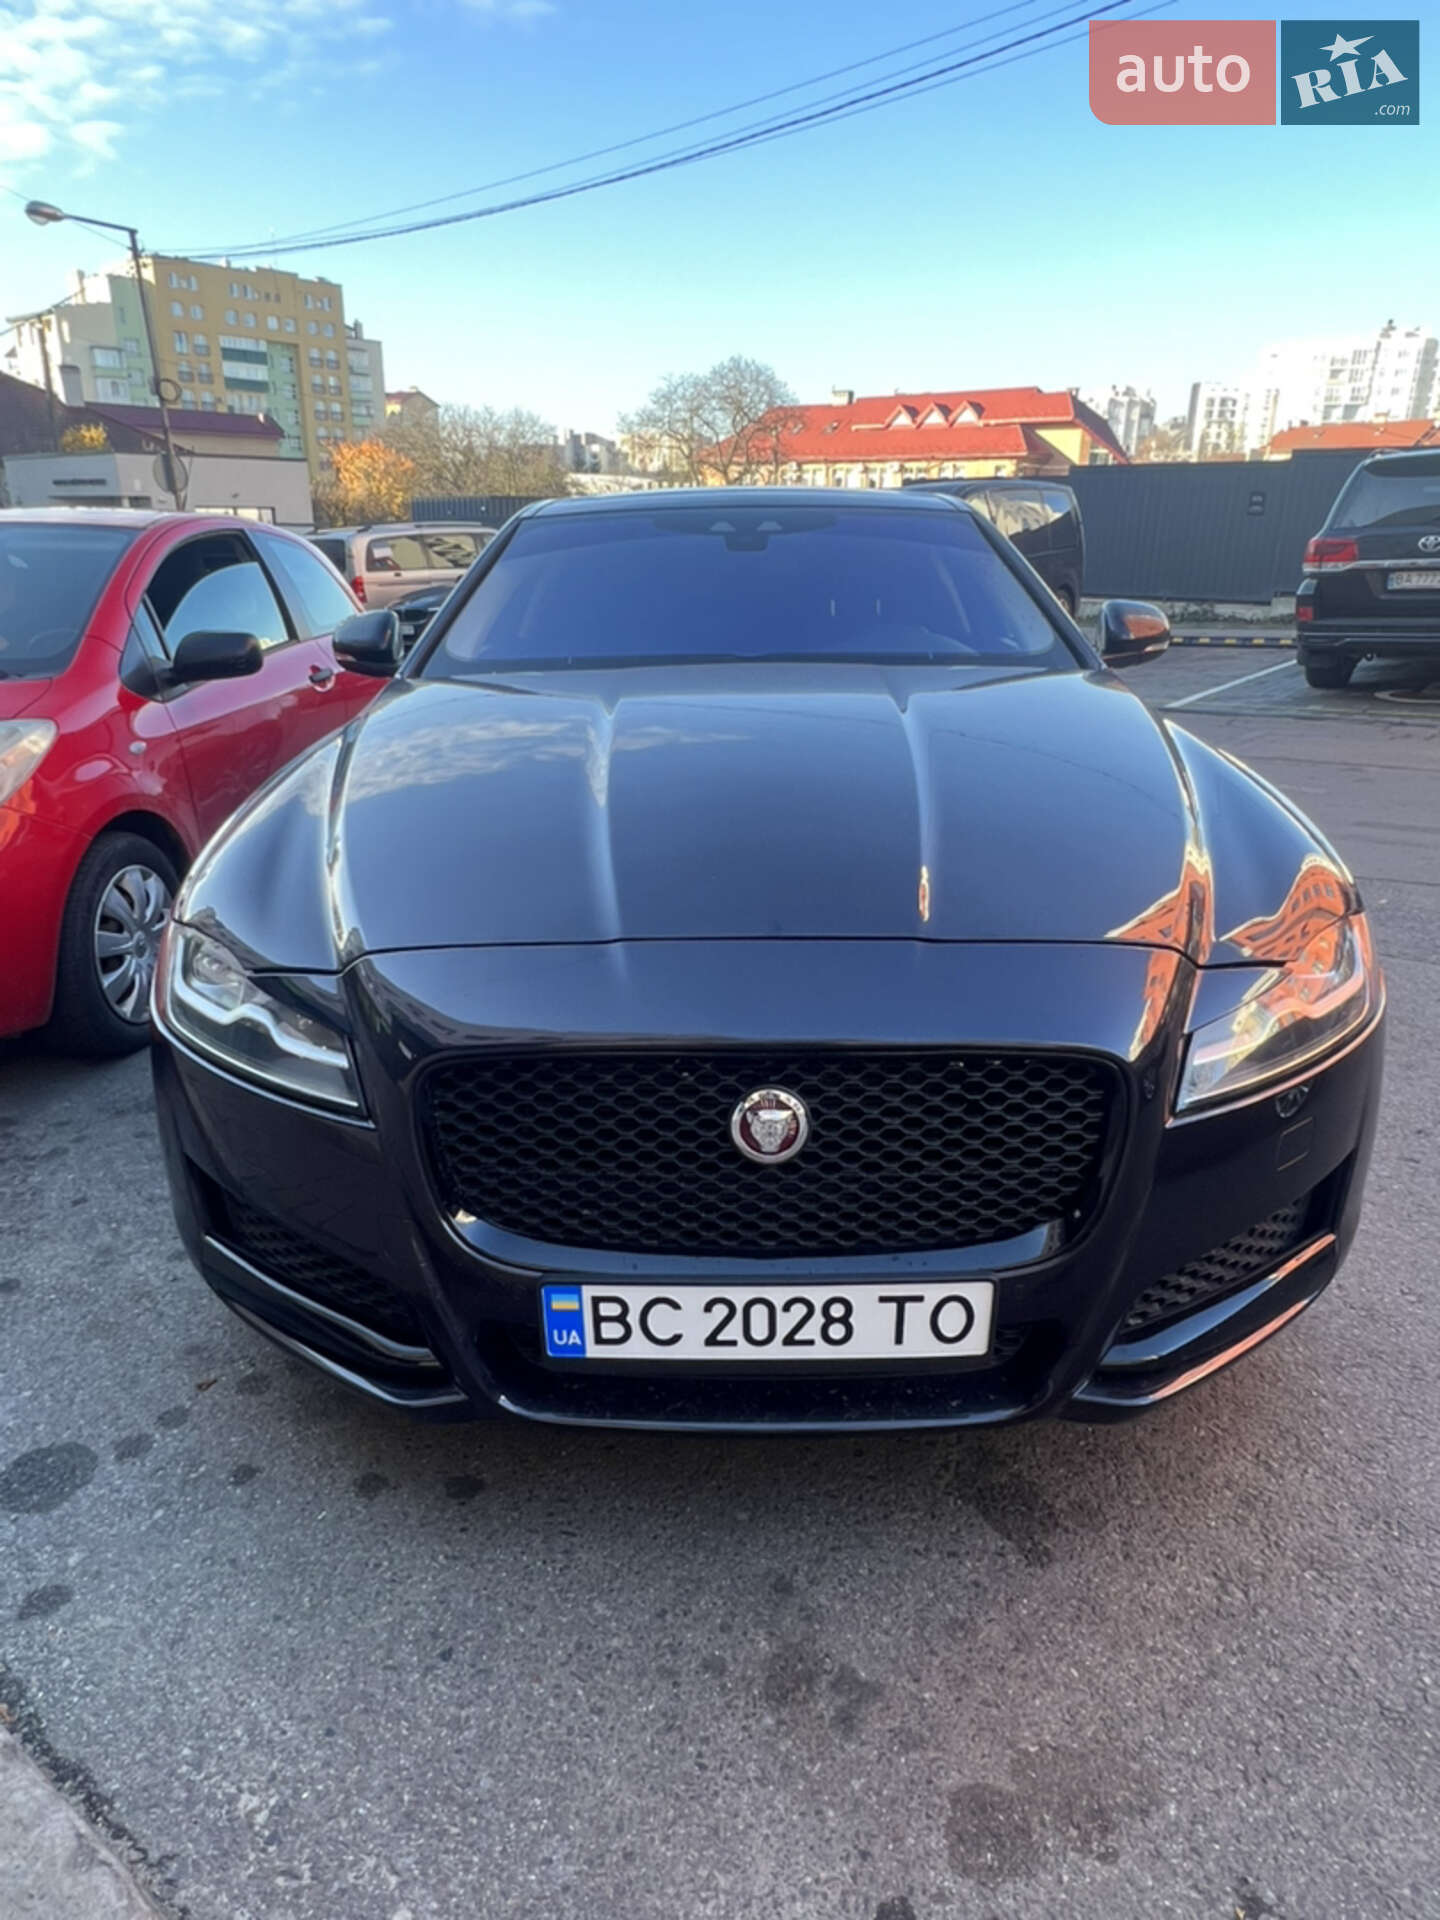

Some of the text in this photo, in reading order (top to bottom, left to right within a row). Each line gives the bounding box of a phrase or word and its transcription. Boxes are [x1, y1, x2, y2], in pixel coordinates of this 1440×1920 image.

[553, 1329, 582, 1345] UA
[591, 1295, 975, 1347] BC 2028 TO
